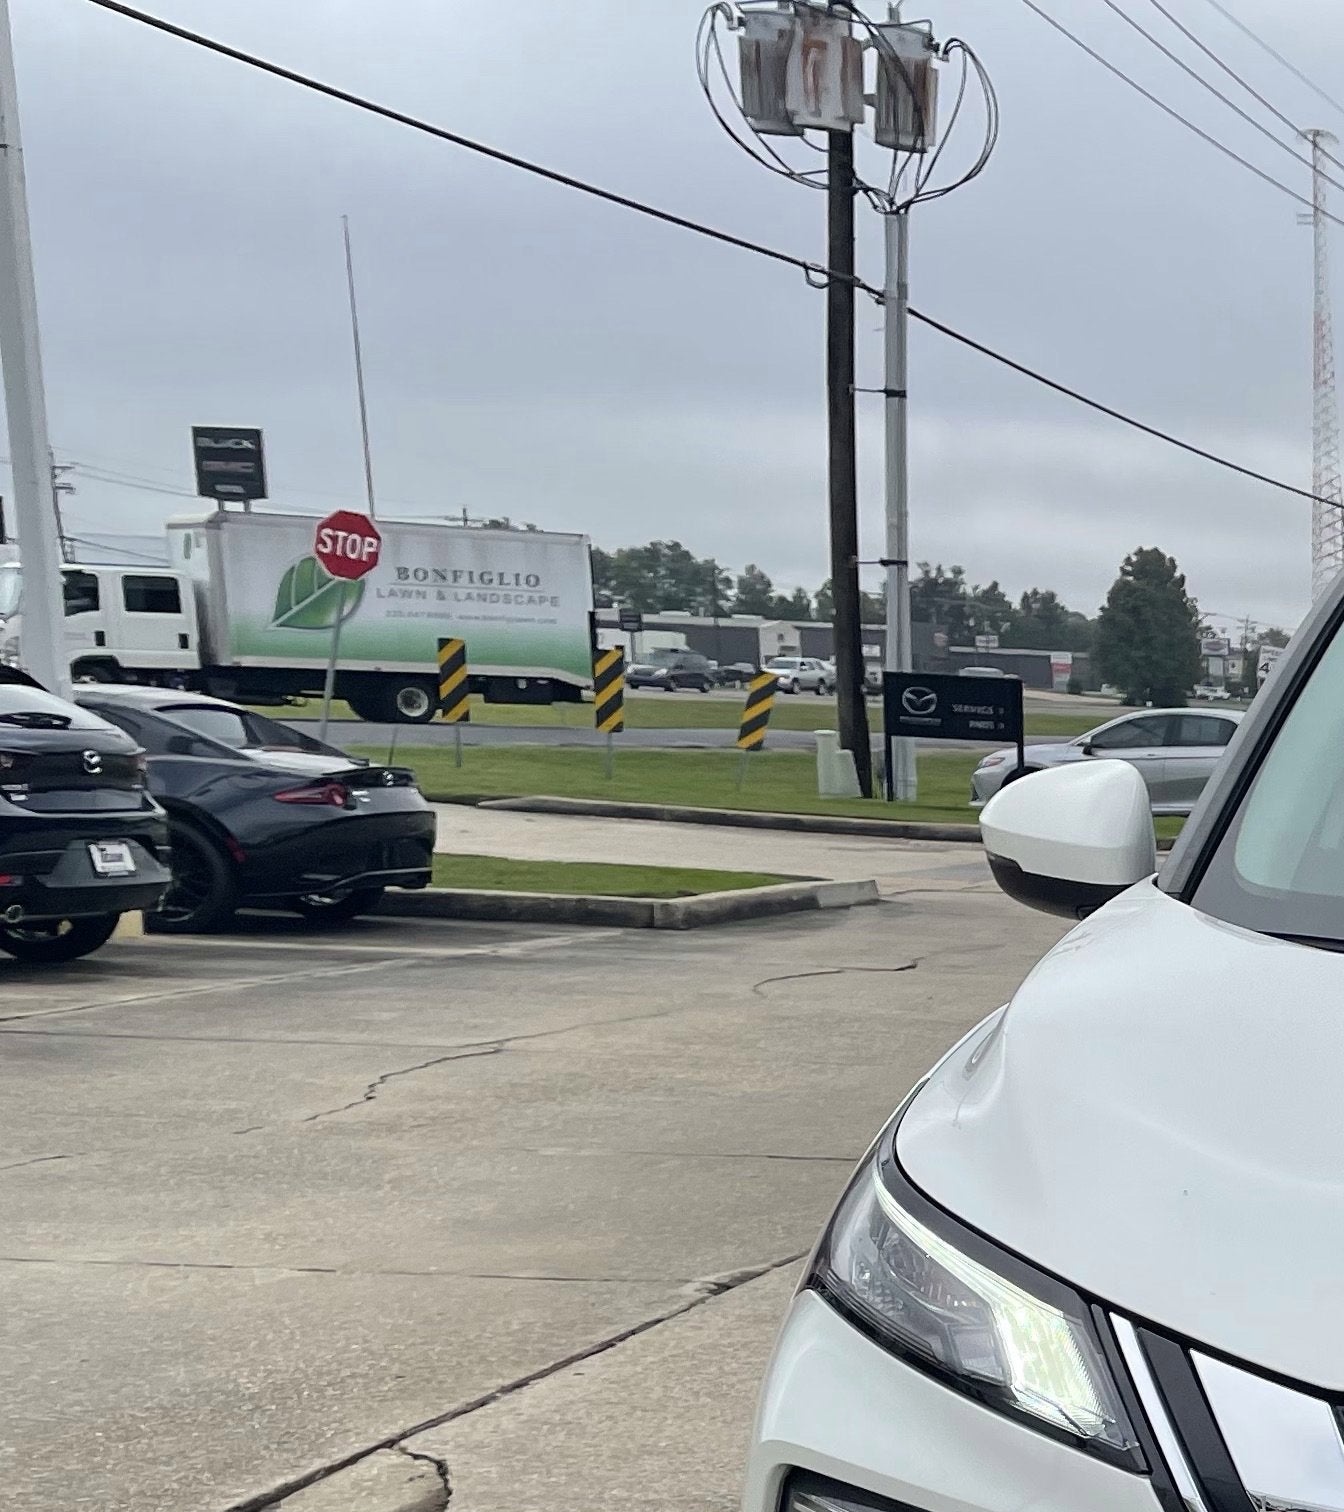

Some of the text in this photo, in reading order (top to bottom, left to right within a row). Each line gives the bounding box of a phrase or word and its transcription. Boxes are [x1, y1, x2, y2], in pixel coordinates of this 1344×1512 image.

[317, 527, 378, 561] STOP
[395, 566, 541, 588] BONFIGLIO
[376, 587, 561, 607] LAWN & LANDSCAPE
